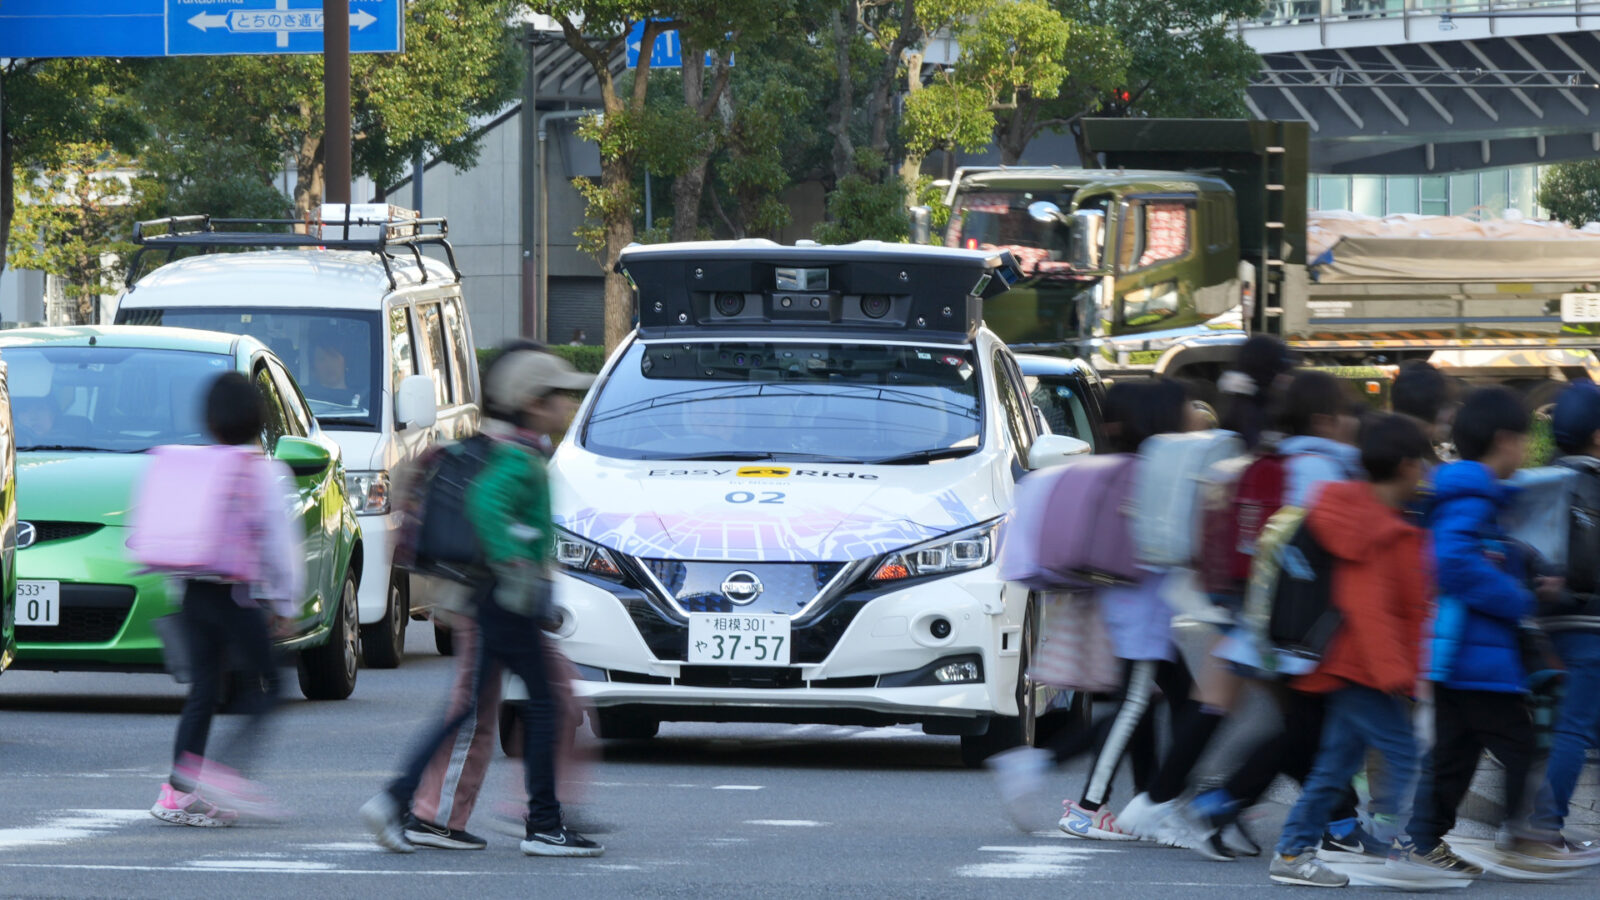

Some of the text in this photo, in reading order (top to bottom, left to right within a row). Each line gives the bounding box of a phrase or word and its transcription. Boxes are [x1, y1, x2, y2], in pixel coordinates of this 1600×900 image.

[648, 468, 879, 480] Easy Ride
[724, 490, 787, 505] 02
[17, 584, 40, 597] 533
[694, 634, 785, 661] や 37-57
